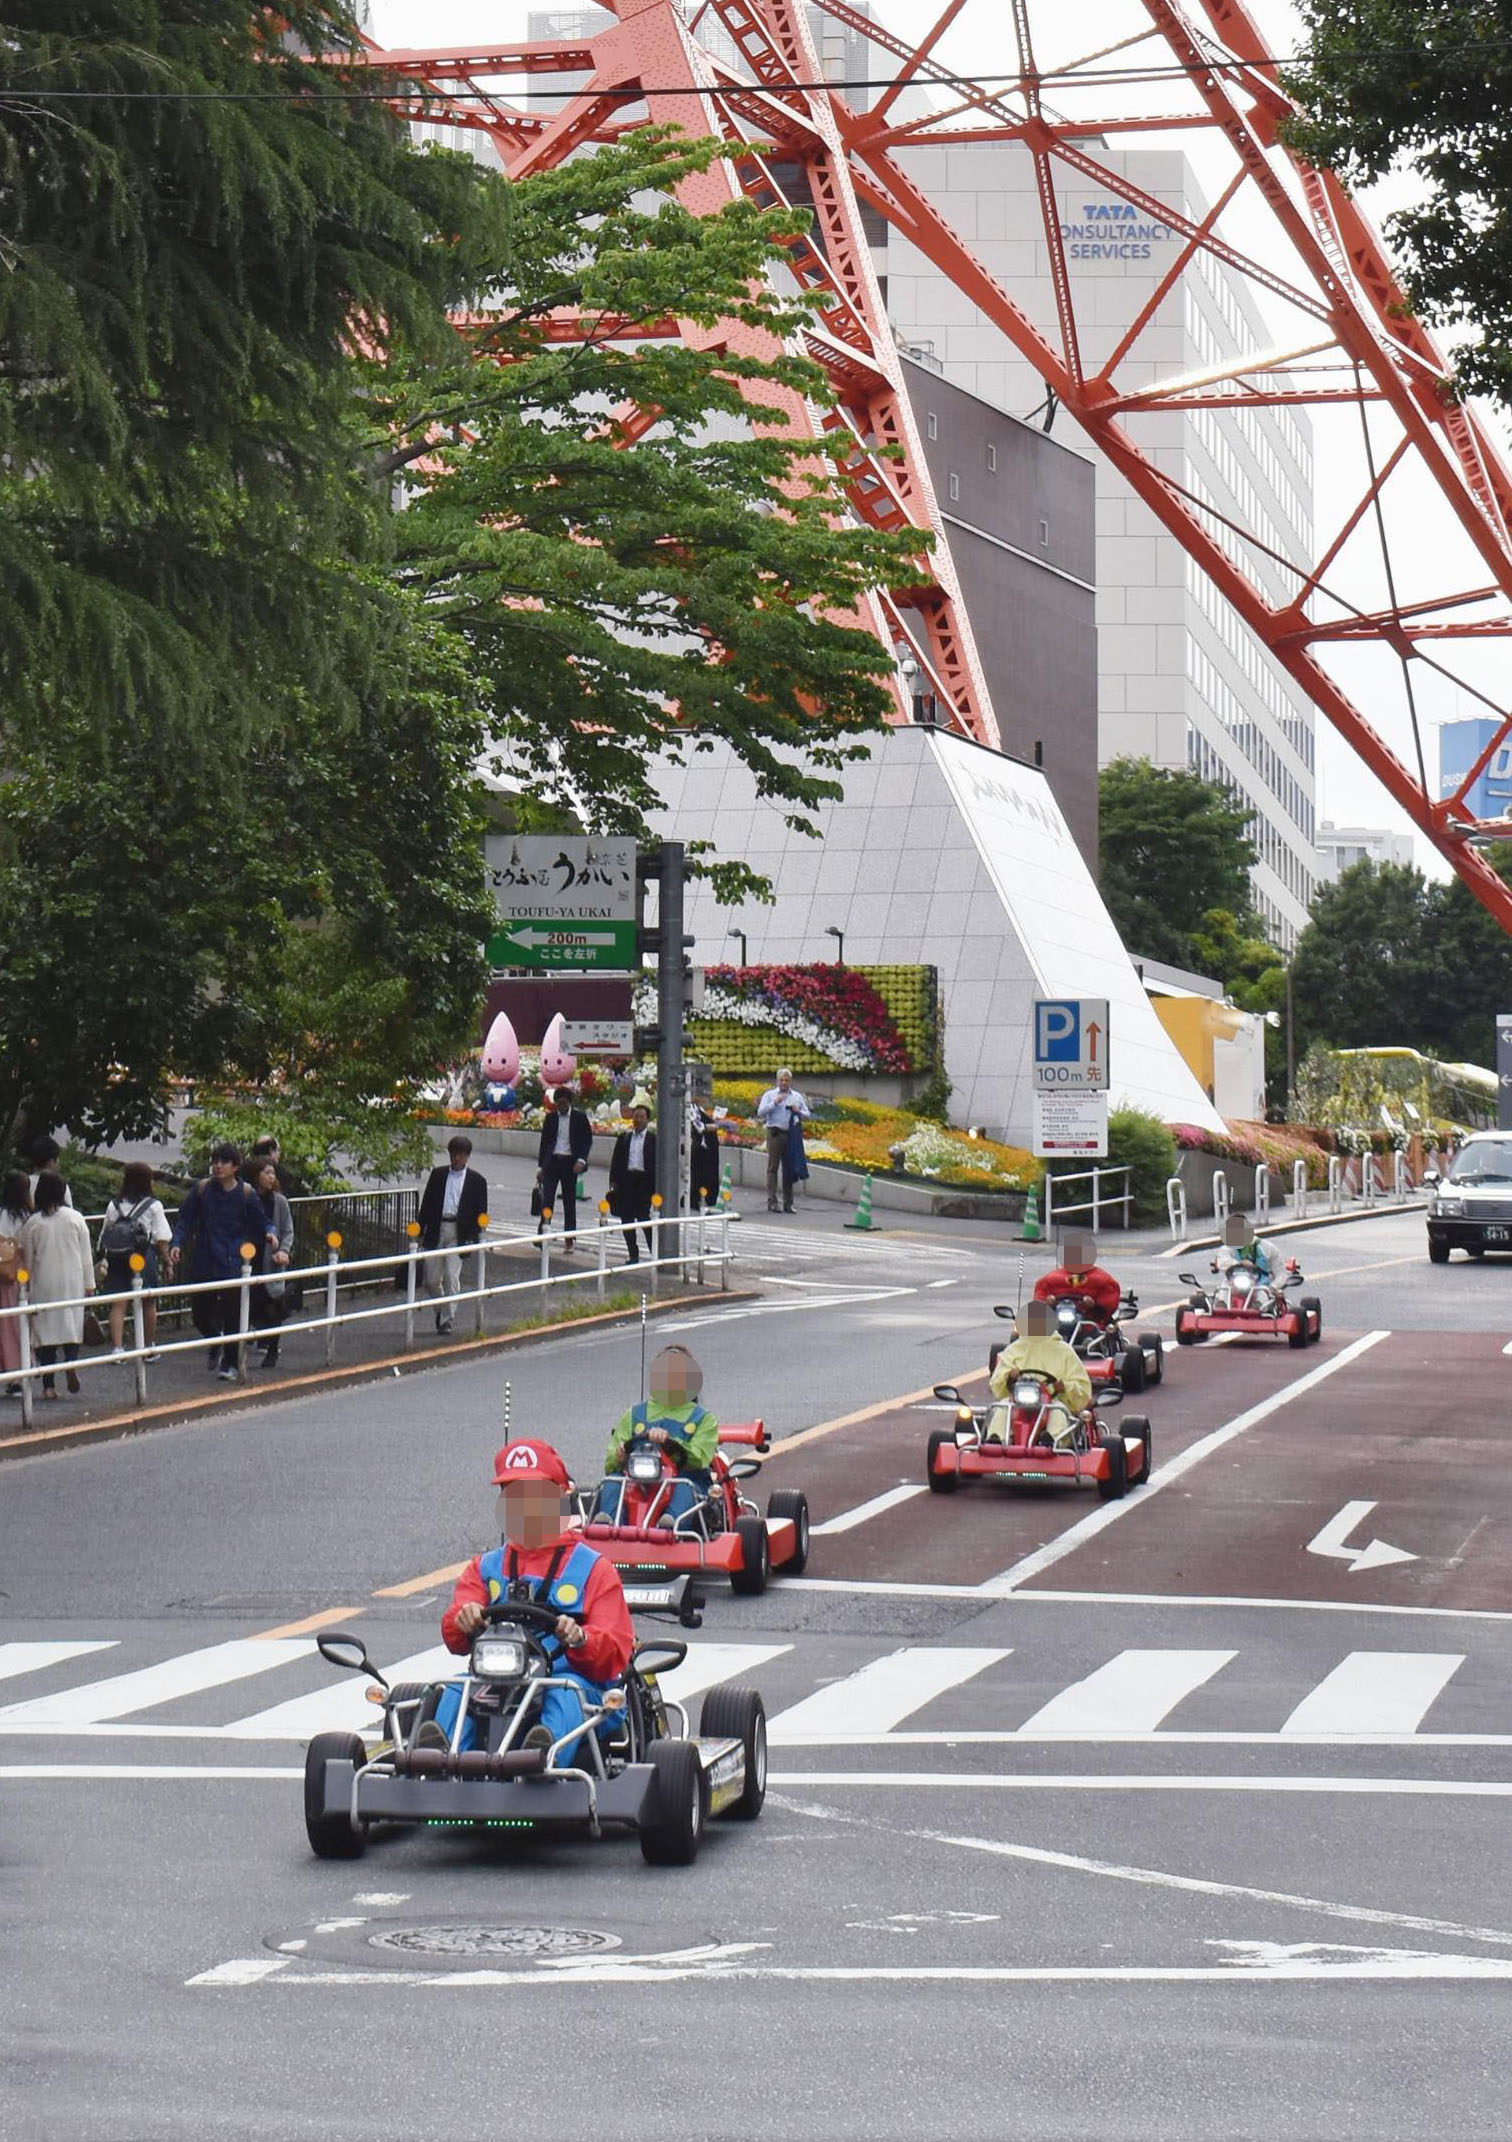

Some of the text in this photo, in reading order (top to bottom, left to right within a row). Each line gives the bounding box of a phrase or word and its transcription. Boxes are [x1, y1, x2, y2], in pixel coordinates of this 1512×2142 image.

[1083, 205, 1137, 220] TATA
[1060, 224, 1172, 240] ONSULTANCY
[1070, 244, 1151, 259] SERVICES
[508, 906, 611, 918] TOUFU-YA UKAI
[548, 931, 587, 944] 200m
[1039, 1005, 1075, 1058] P
[508, 1449, 535, 1468] M
